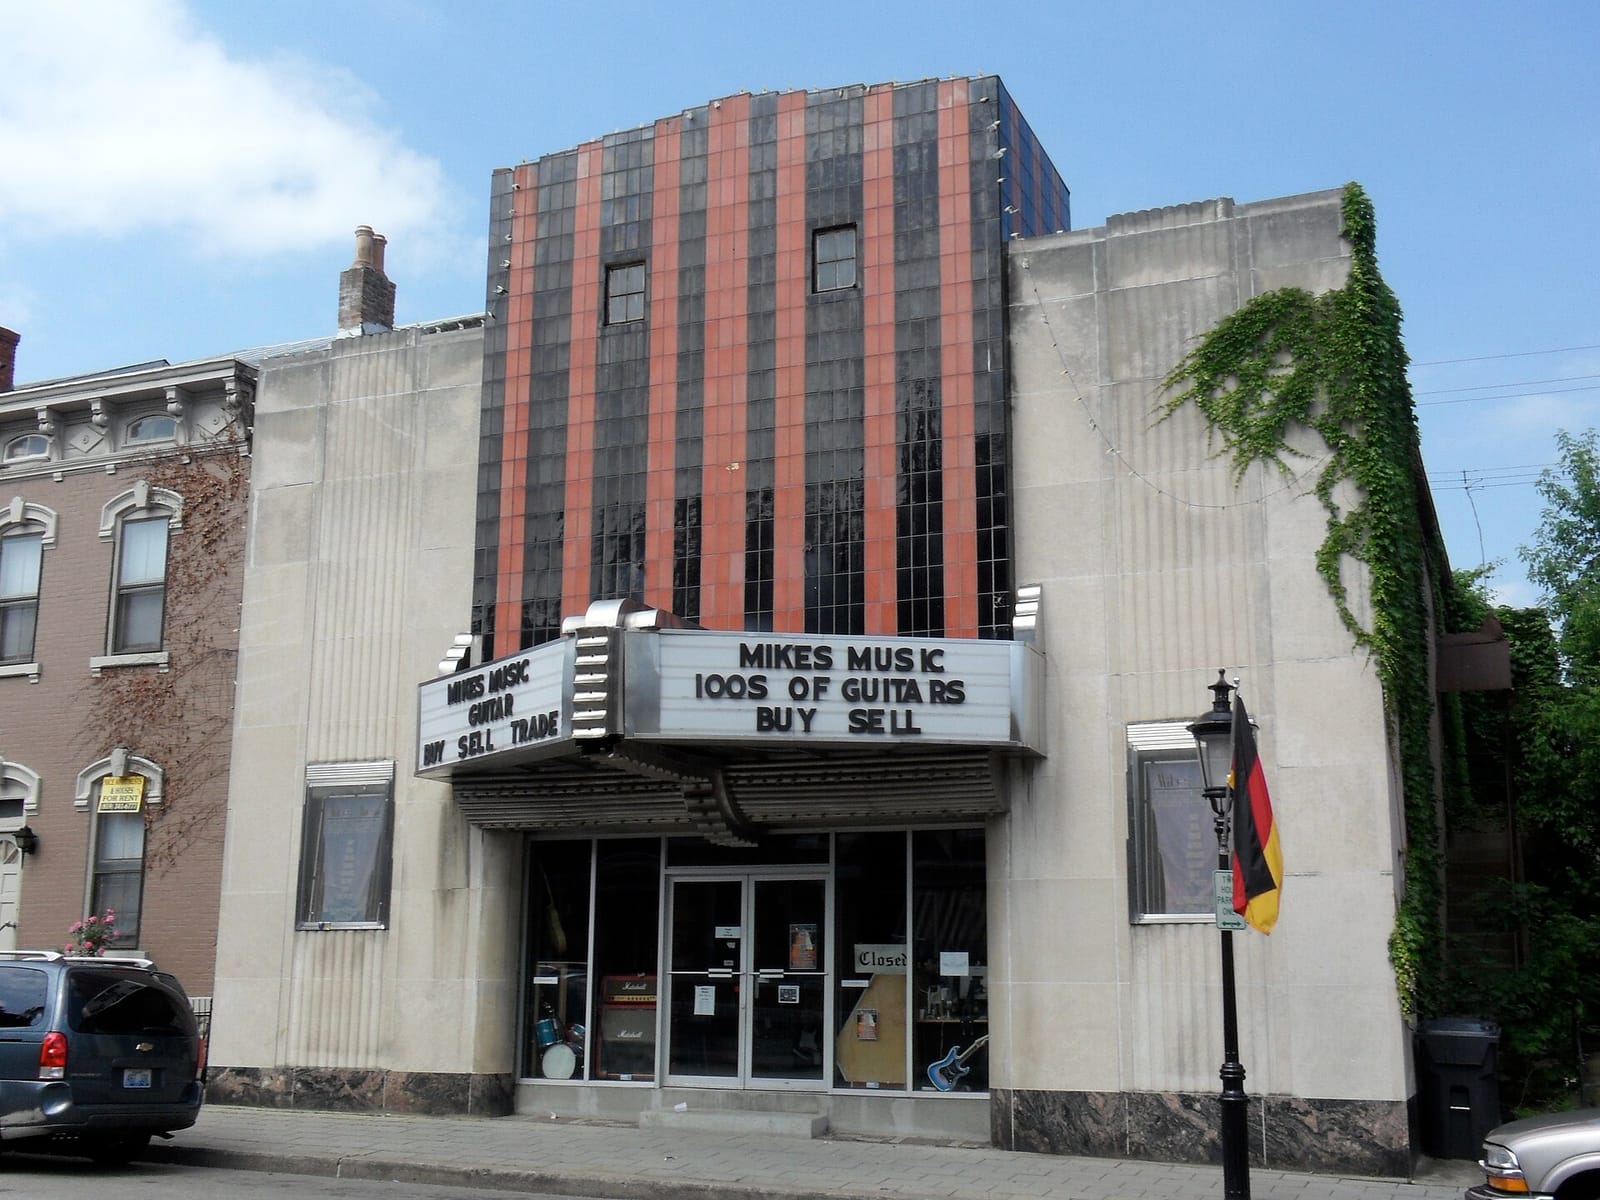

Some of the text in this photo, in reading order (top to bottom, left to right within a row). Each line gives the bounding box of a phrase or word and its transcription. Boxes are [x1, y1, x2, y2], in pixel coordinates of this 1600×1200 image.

[739, 643, 945, 673] MIKES MUSIC
[447, 658, 530, 705] MIKES MUSIC
[788, 675, 830, 701] OF
[841, 677, 966, 704] GUITARS
[468, 693, 514, 727] GUITAR
[756, 706, 922, 735] BUY SELL
[423, 710, 559, 767] BUY SELL TRADE
